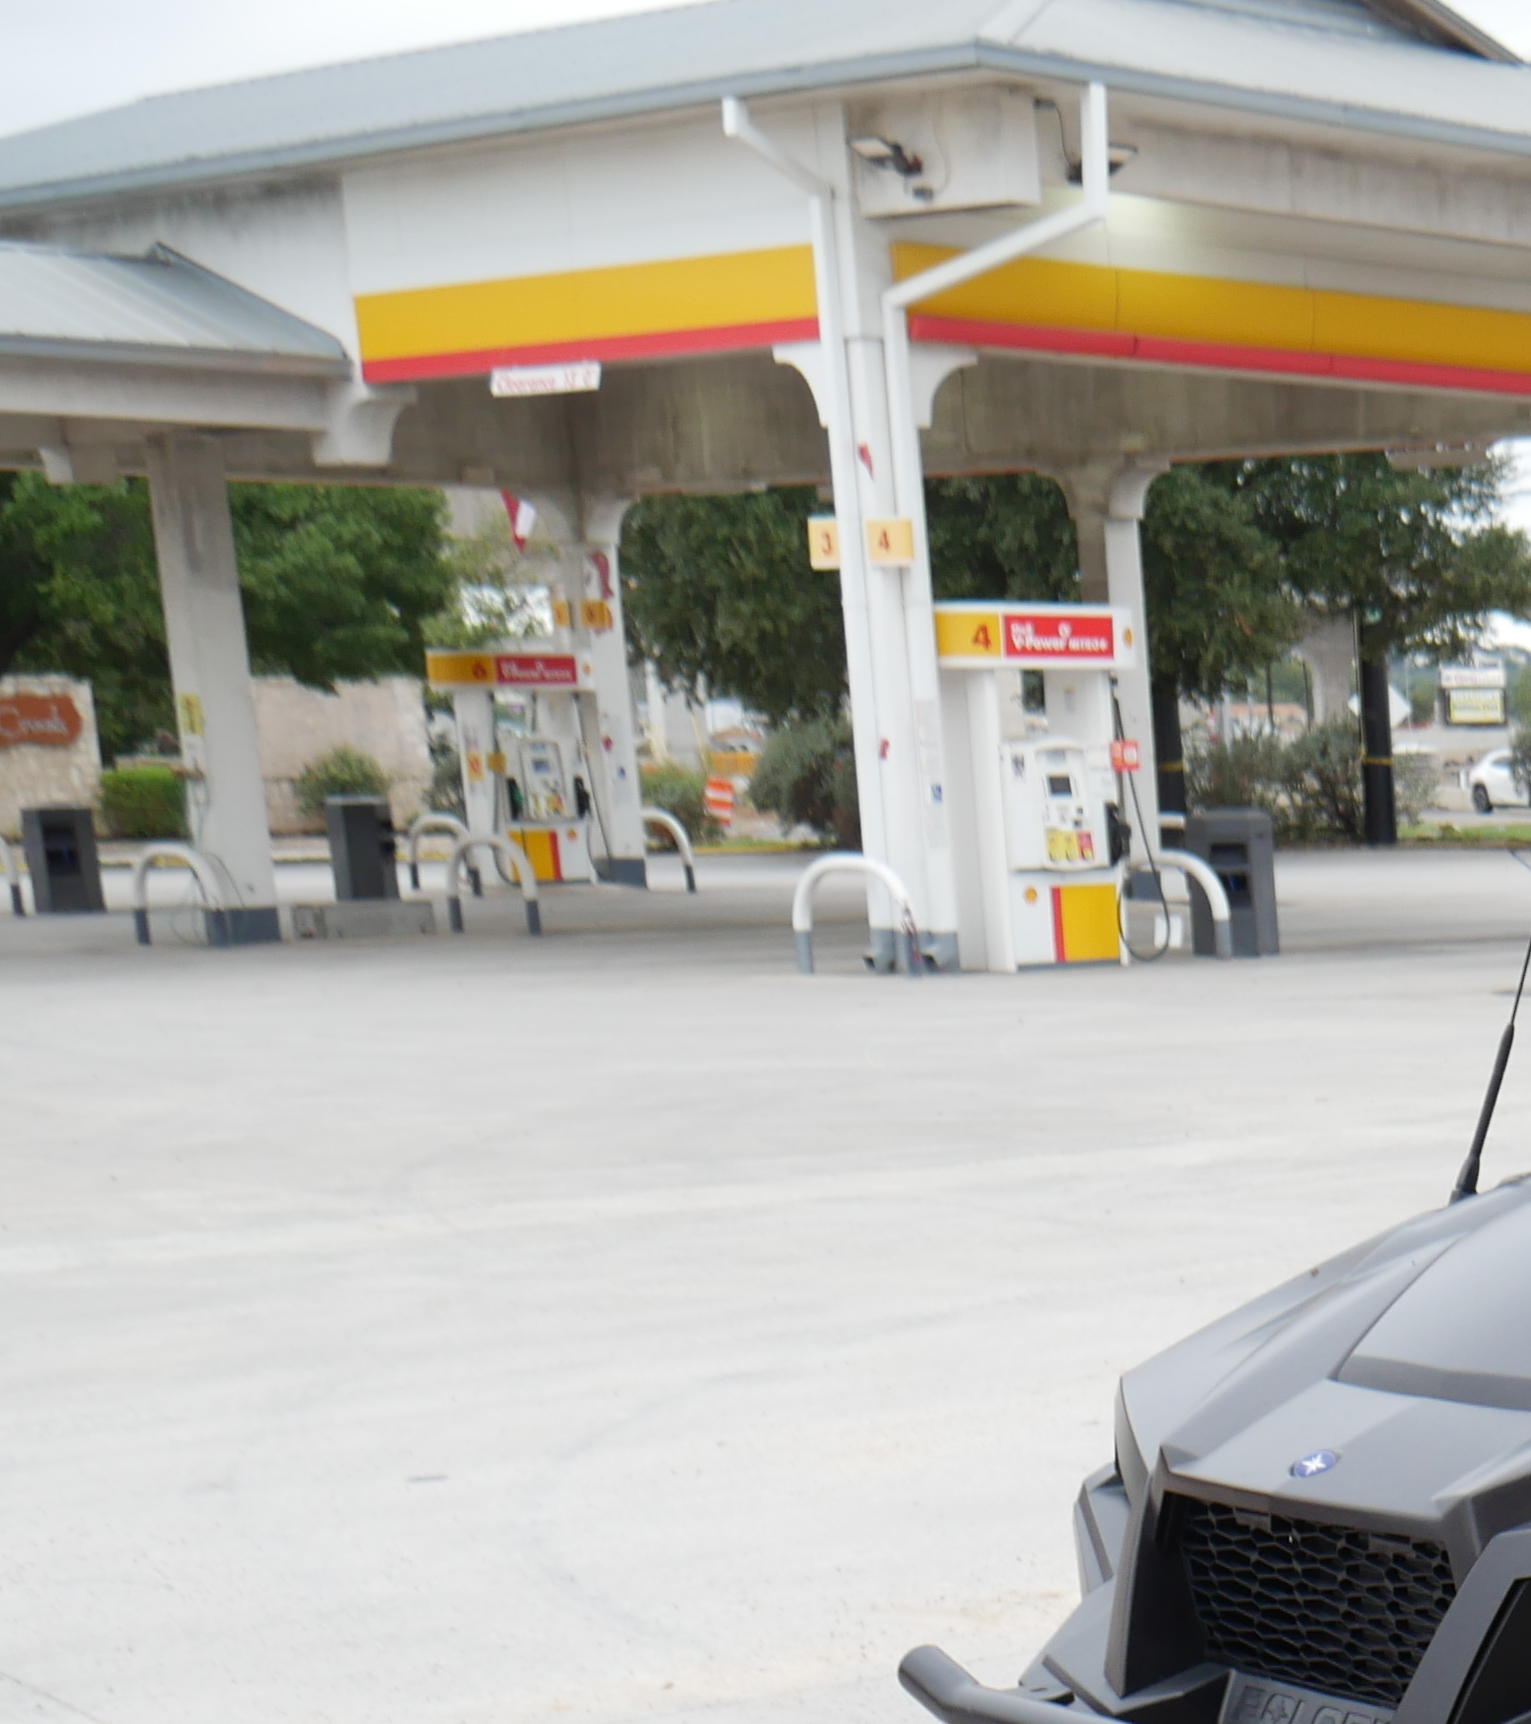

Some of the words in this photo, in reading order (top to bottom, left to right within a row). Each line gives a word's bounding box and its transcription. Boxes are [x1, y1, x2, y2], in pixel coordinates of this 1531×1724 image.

[822, 530, 833, 556] 3
[877, 528, 891, 554] 4
[972, 623, 992, 650] 4
